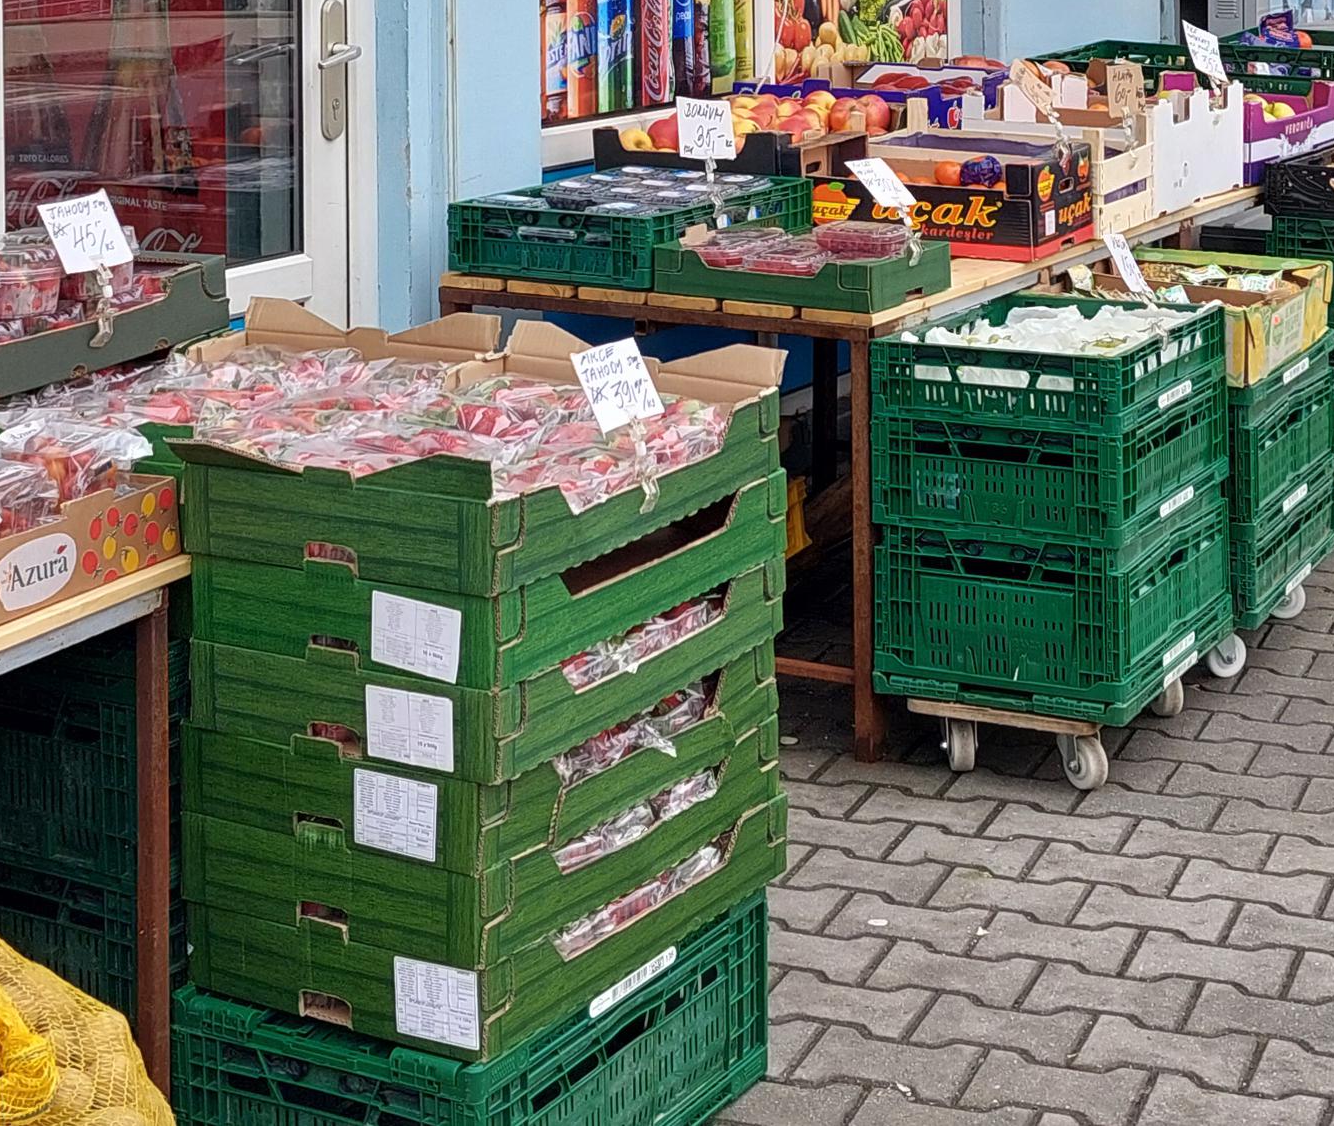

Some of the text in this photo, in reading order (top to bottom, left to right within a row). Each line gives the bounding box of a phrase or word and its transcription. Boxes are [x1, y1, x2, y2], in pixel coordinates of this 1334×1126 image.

[46, 200, 90, 220] JAHODY
[143, 199, 167, 211] TASTE
[581, 359, 623, 384] JAHODY
[9, 554, 69, 592] Azura
